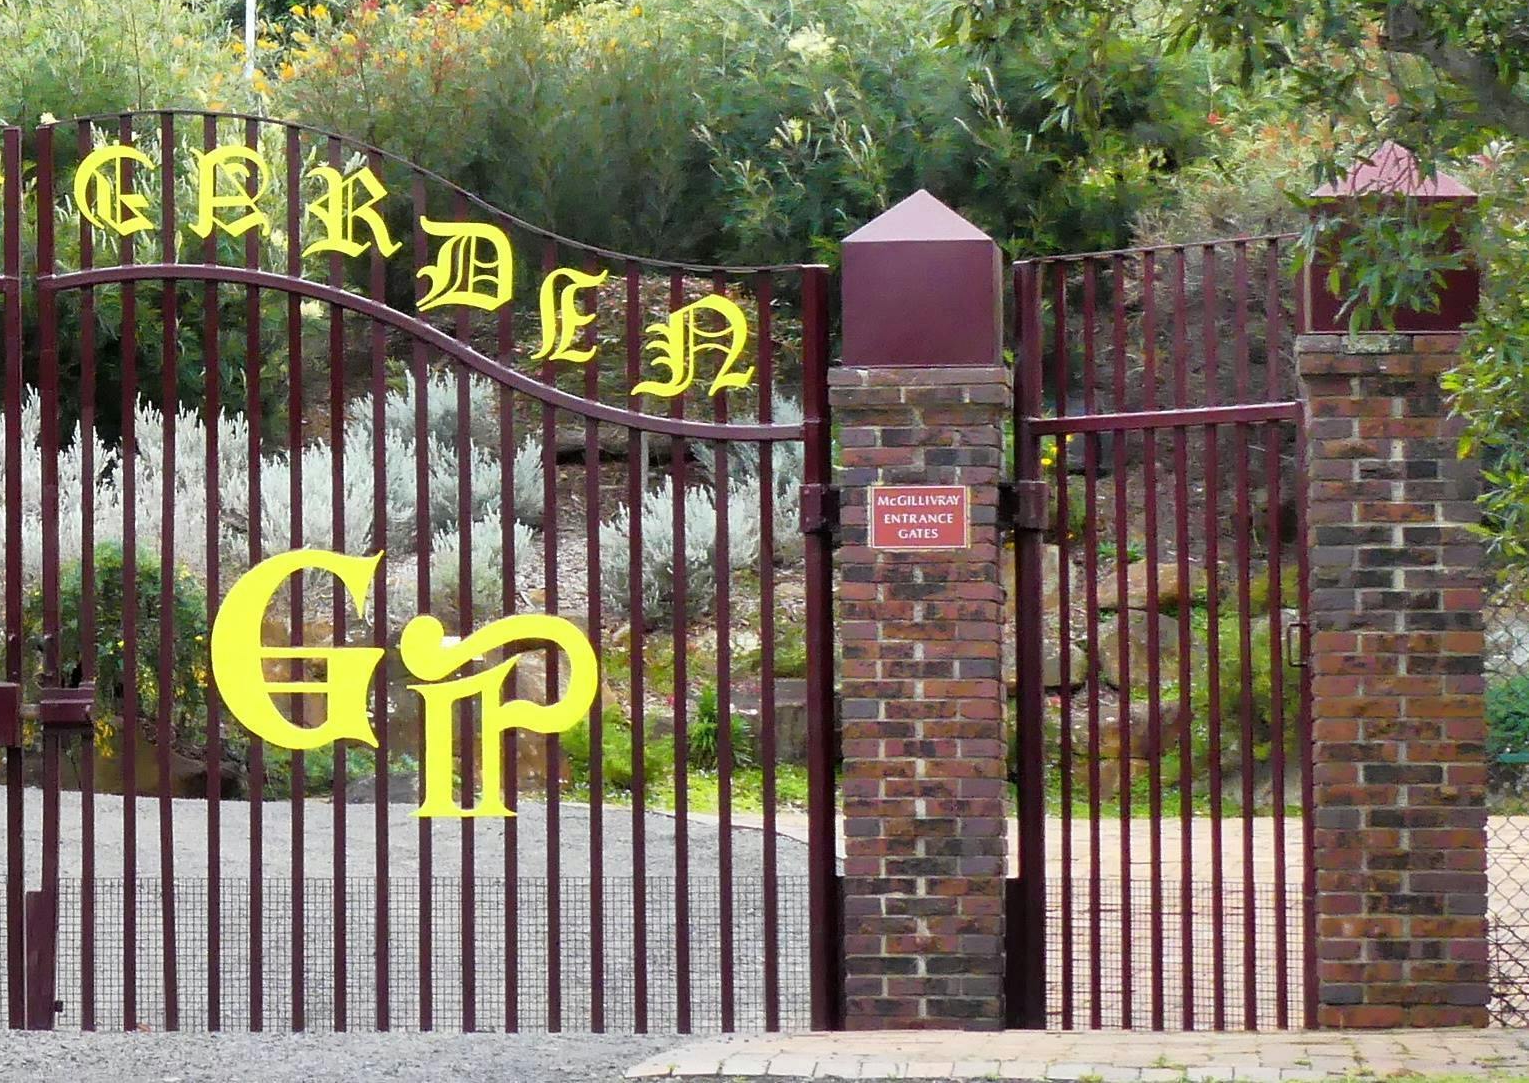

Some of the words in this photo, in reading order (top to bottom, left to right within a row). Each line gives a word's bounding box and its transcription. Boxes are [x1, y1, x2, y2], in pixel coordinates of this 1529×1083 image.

[73, 144, 756, 397] GARDEN
[877, 495, 960, 506] McGILLIVRAY
[884, 513, 954, 524] ENTRANCE
[898, 528, 939, 539] GATES
